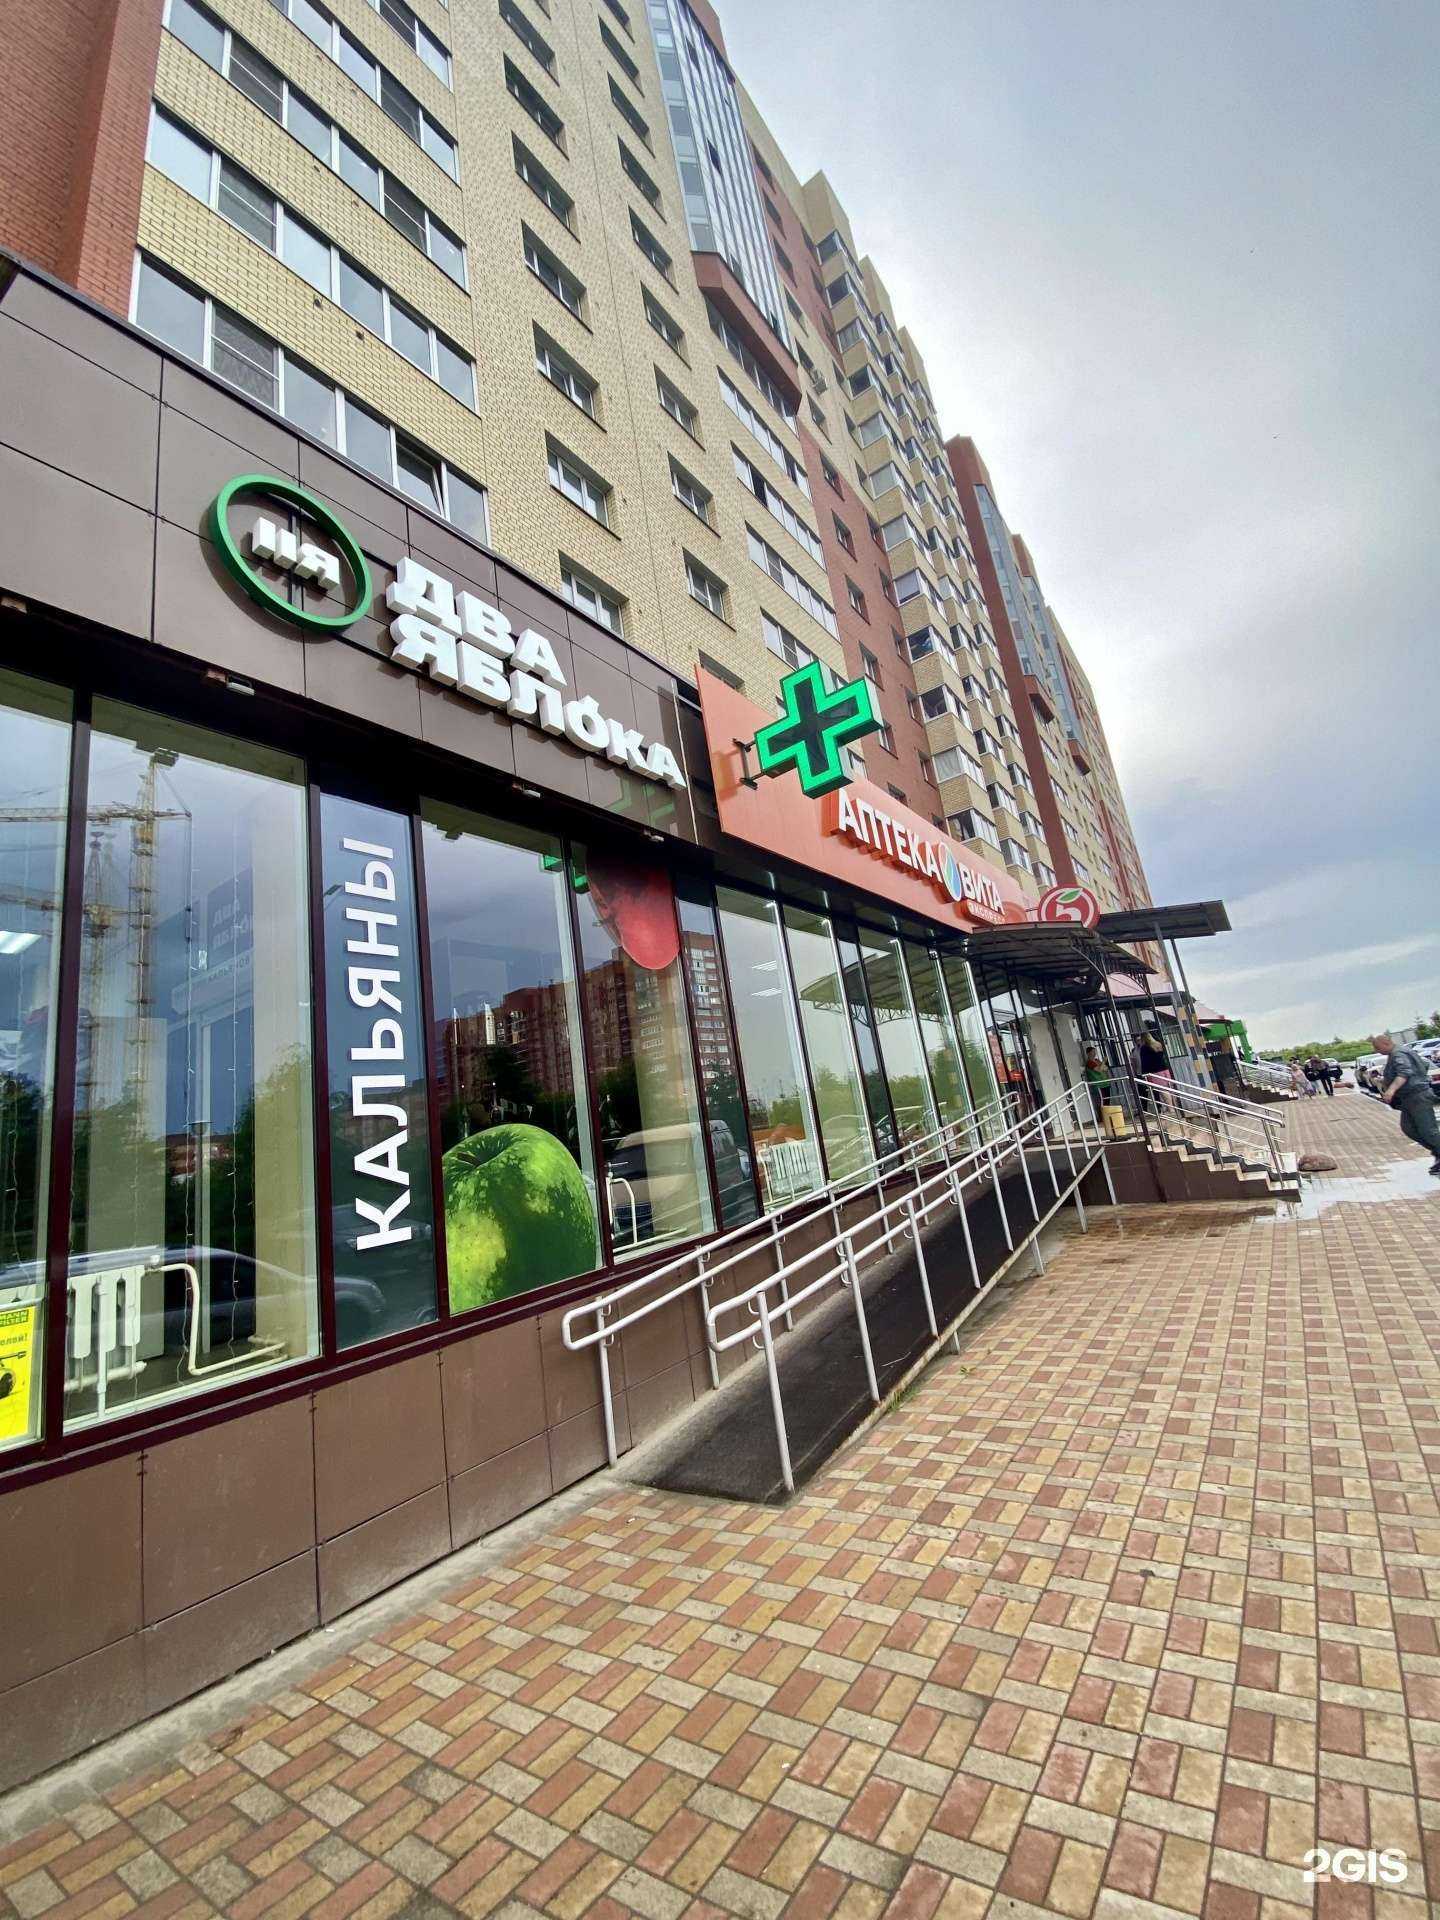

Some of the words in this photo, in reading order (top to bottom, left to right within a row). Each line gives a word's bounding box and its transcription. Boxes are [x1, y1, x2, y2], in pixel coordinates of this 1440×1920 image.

[385, 556, 567, 688] ДВА
[389, 613, 686, 791] ЯБЛОКА
[838, 787, 943, 883] АПТЕКА
[958, 862, 1006, 916] ВИТА
[341, 837, 413, 1251] КАЛЬЯНЫ
